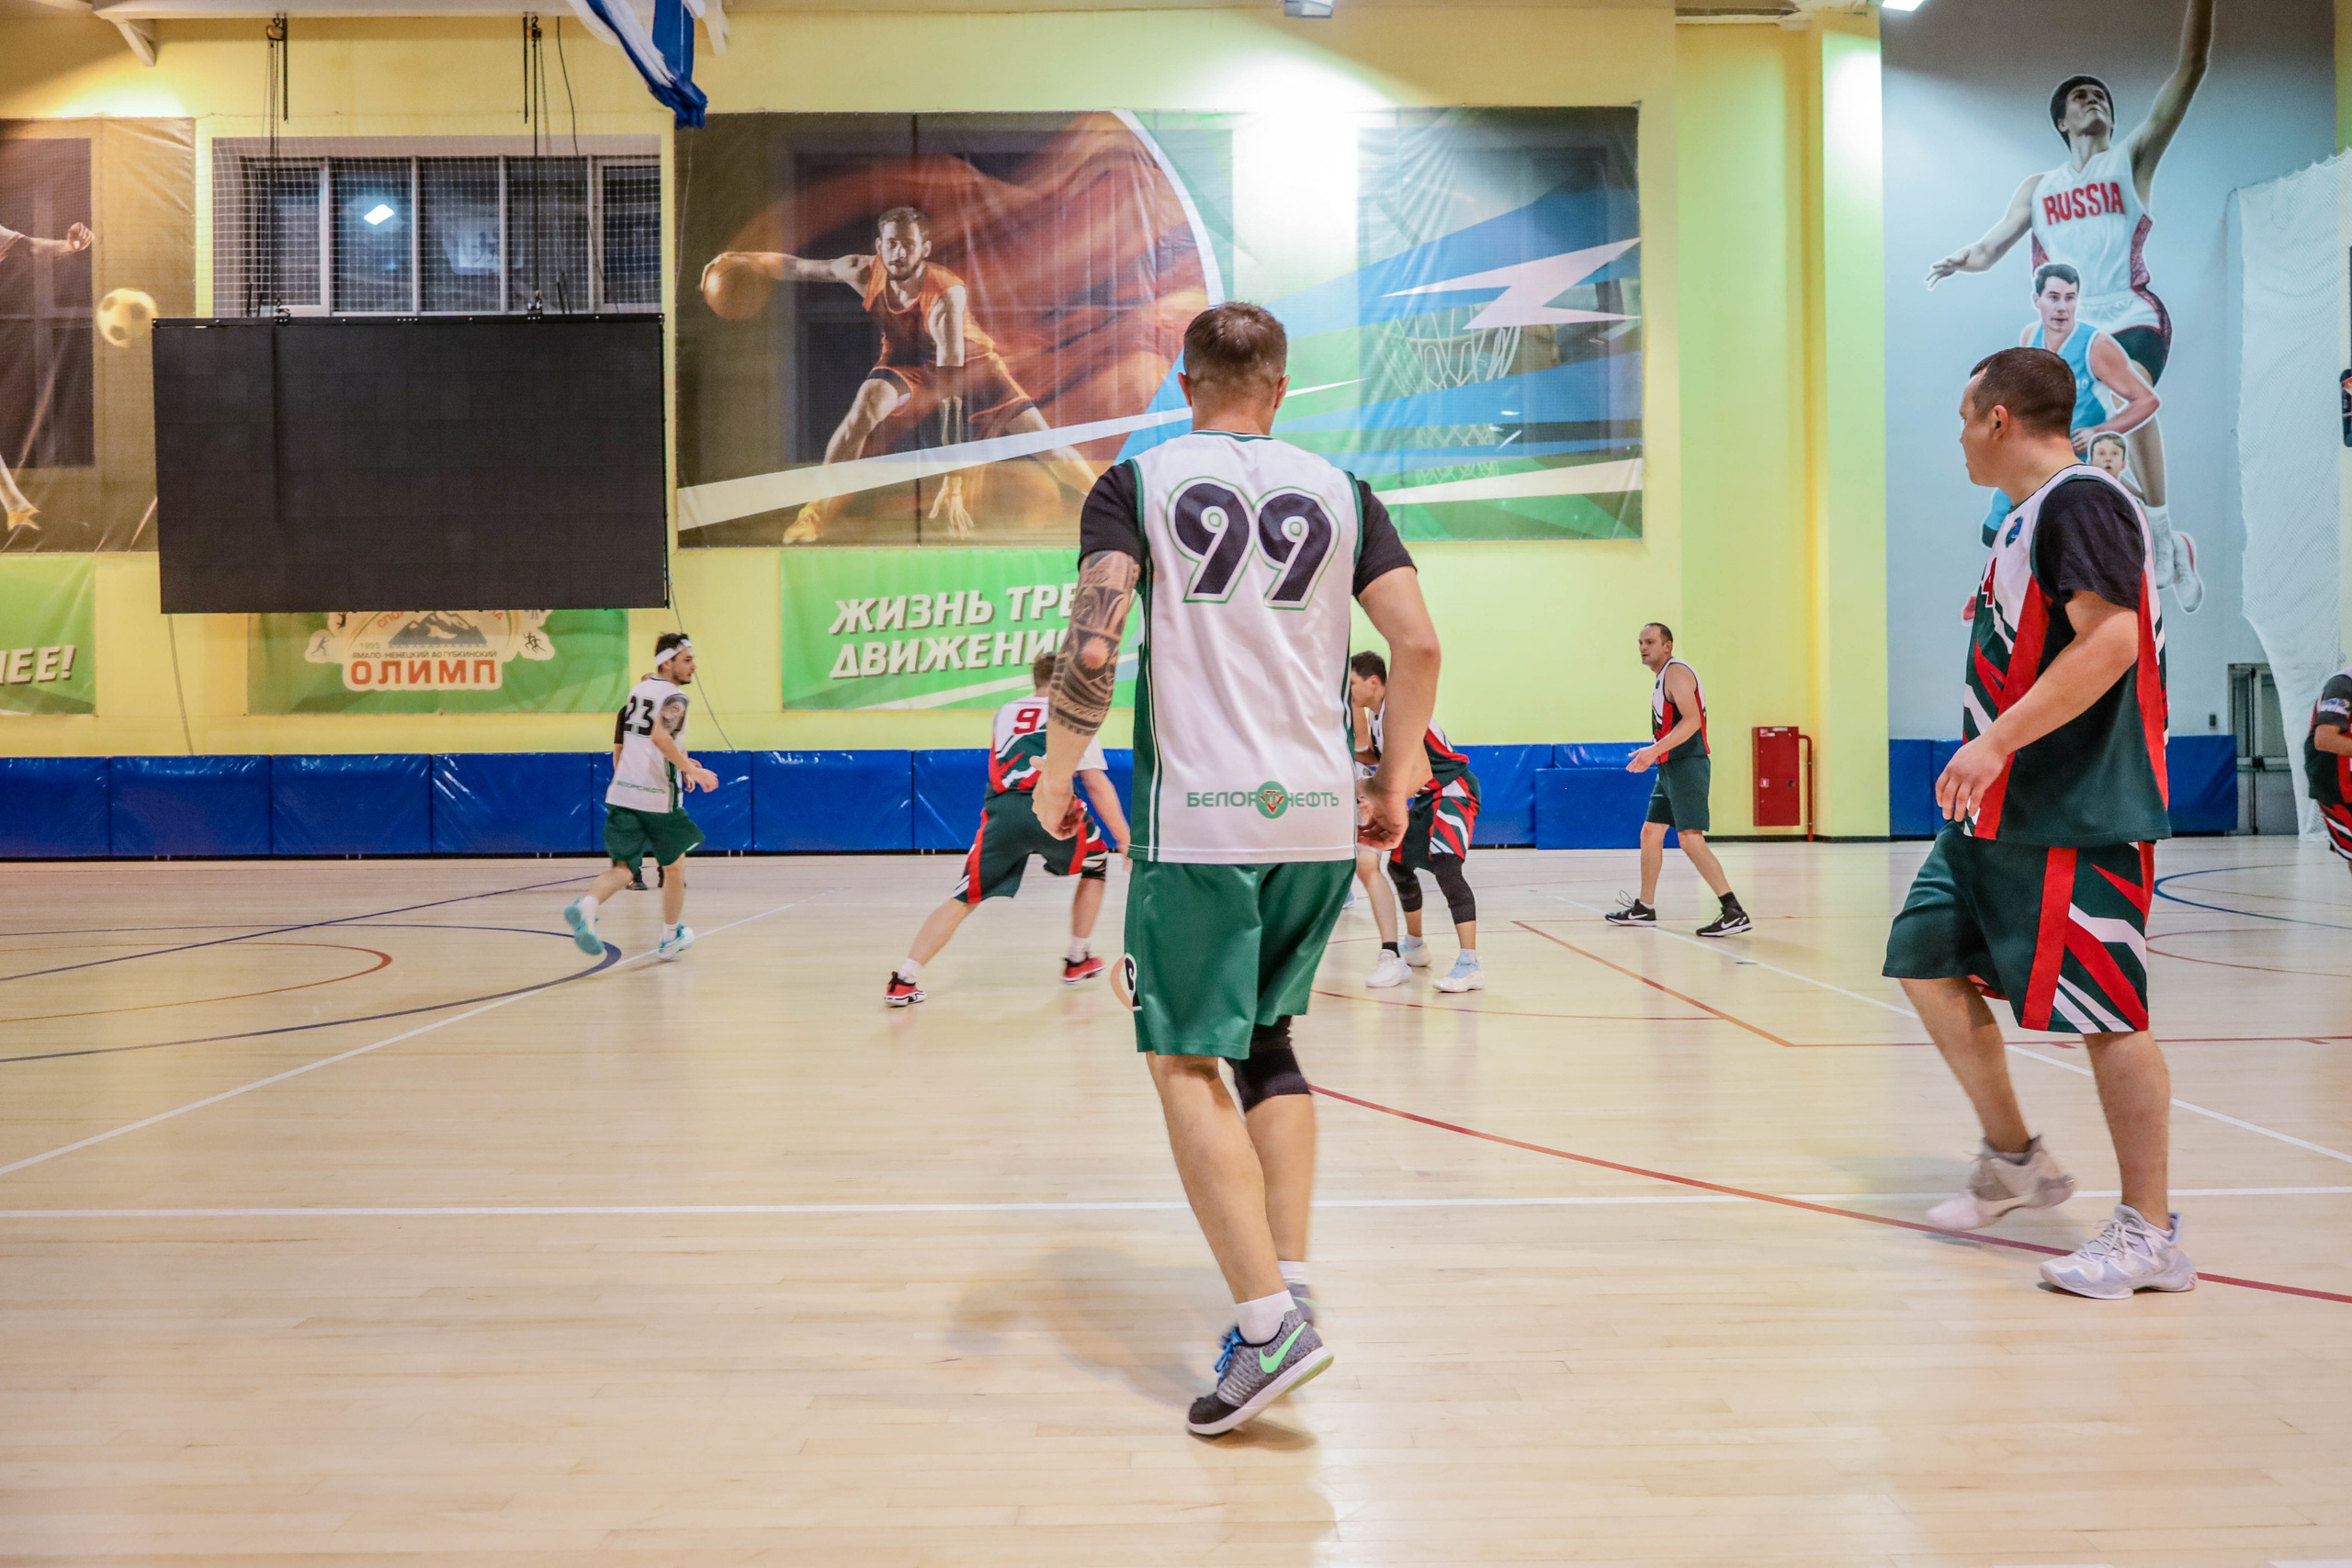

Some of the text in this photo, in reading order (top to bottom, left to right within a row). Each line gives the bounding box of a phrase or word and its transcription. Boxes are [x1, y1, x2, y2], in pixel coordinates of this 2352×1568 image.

[2042, 181, 2126, 226] RUSSIA
[1166, 476, 1340, 611] 99
[828, 582, 1079, 637] ЖИЗНЬ ТРЕ
[0, 644, 77, 685] ЕЕ!
[350, 659, 497, 685] ОЛИМП
[623, 694, 654, 737] 23
[1013, 708, 1042, 735] 9
